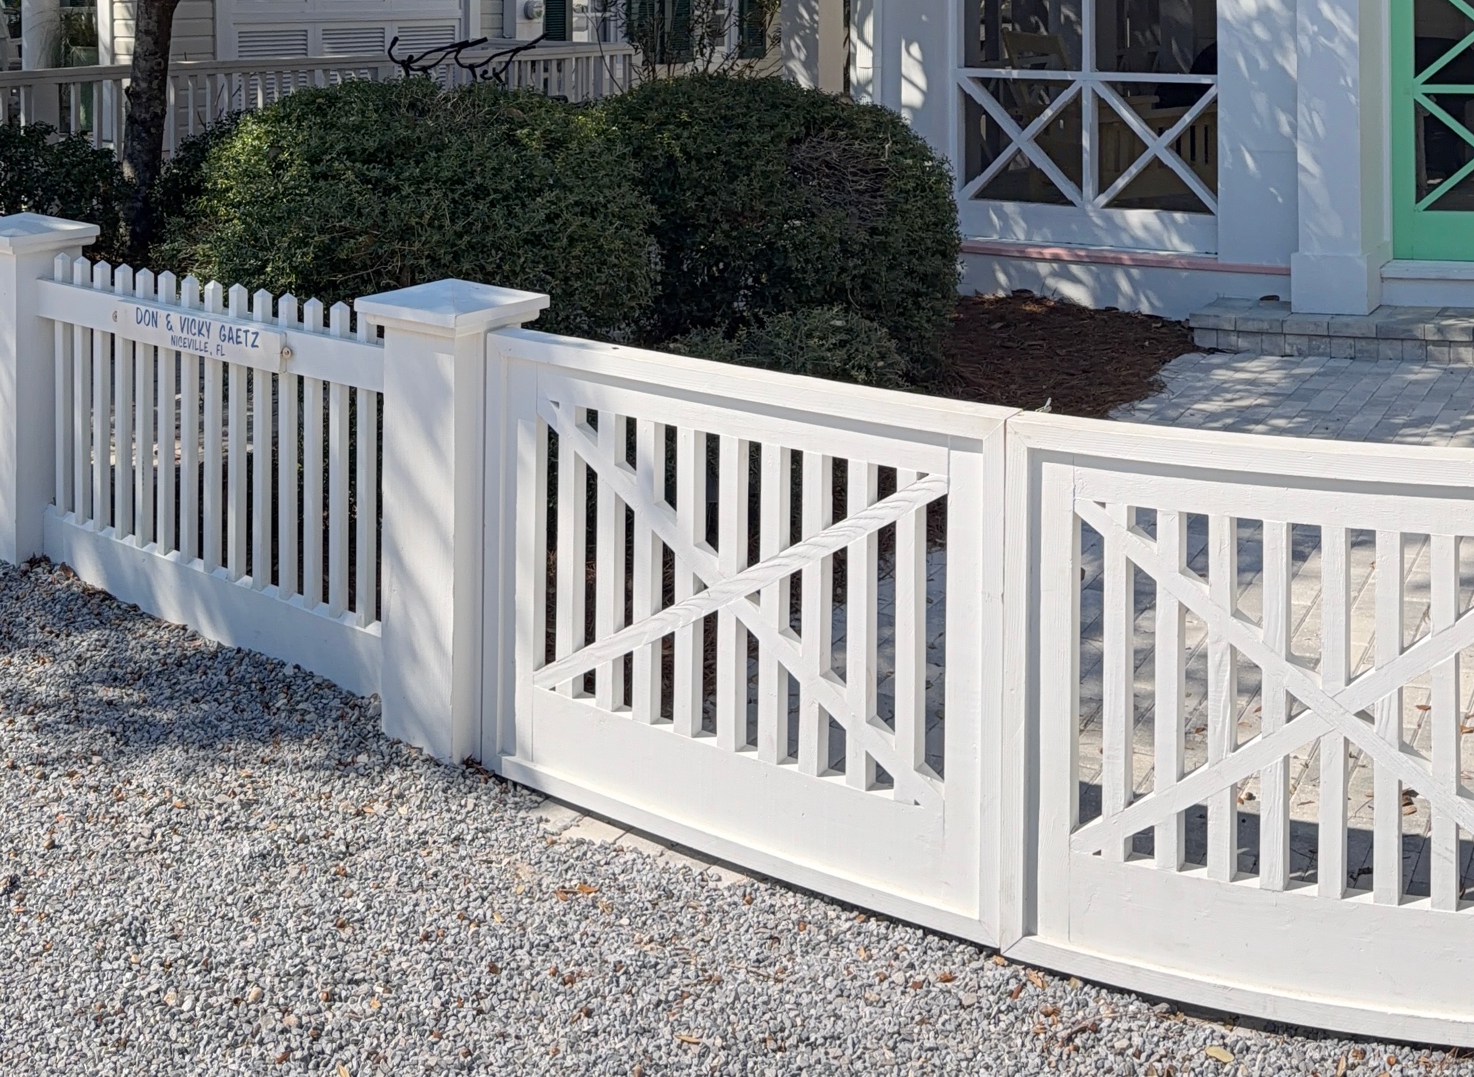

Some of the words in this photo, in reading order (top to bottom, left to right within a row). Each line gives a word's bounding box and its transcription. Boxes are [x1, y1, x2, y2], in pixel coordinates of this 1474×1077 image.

[136, 307, 158, 329] DON
[165, 313, 174, 332] &
[179, 316, 212, 339] VICKY
[219, 324, 260, 349] GAETZ
[216, 344, 226, 357] FL
